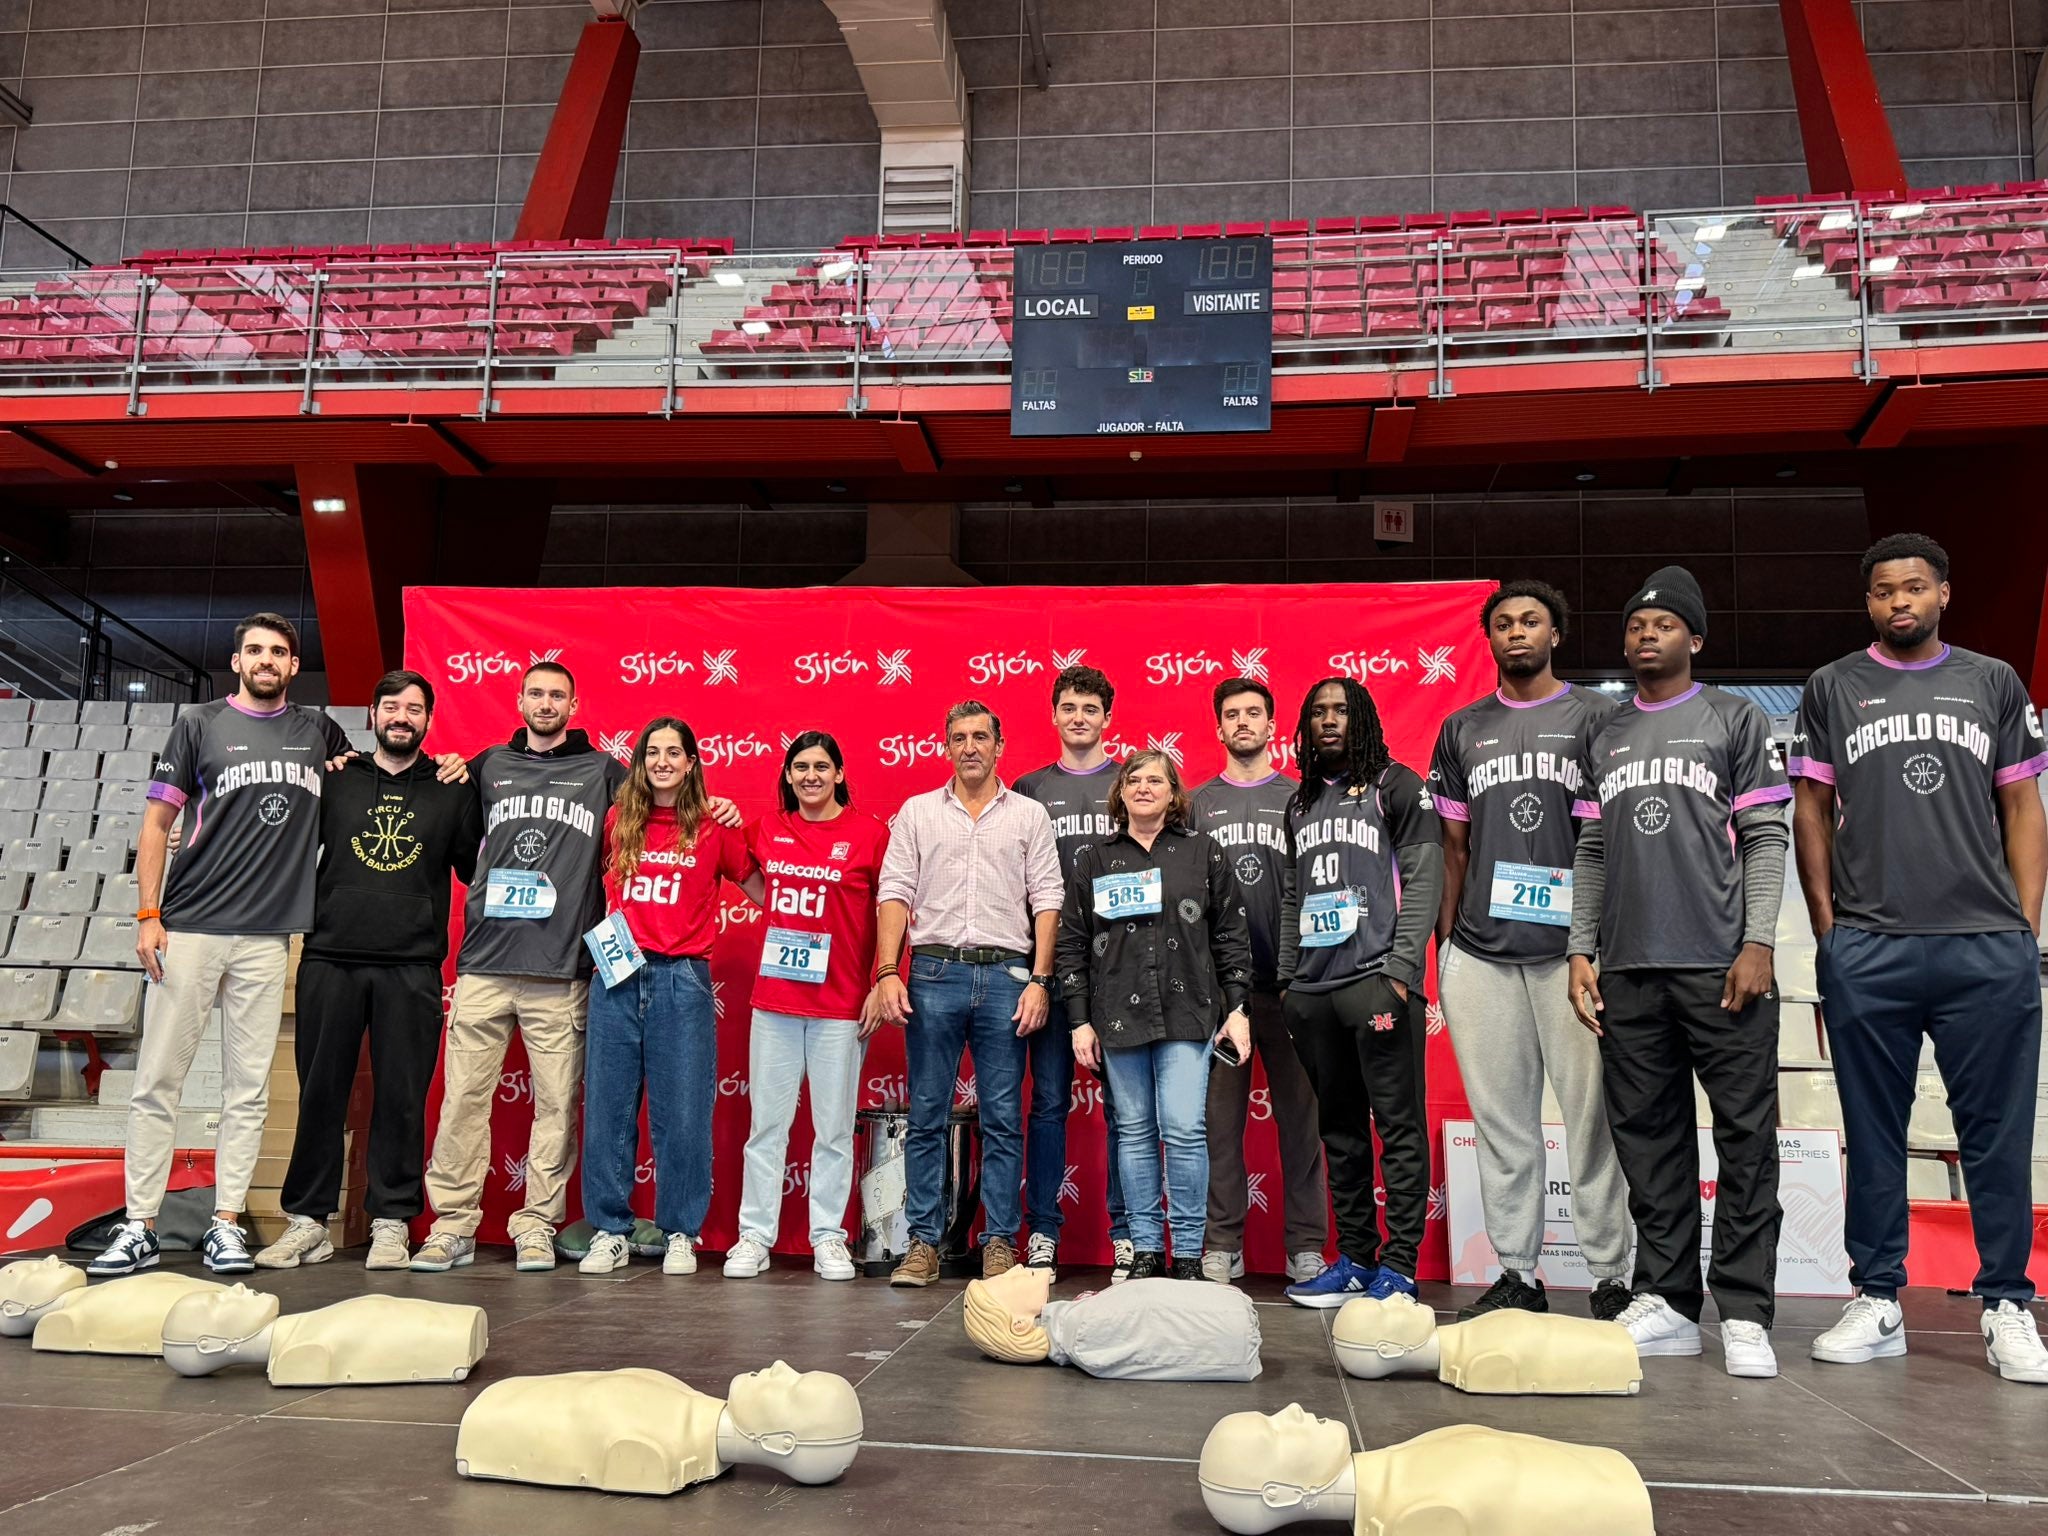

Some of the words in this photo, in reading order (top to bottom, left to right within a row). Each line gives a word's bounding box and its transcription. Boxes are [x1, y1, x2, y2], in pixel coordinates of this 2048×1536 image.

[1123, 254, 1163, 265] PERIODO
[1024, 298, 1091, 317] LOCAL
[1193, 292, 1260, 312] VISITANTE
[1022, 400, 1056, 411] FALTAS
[1223, 396, 1258, 407] FALTAS
[1097, 422, 1145, 433] JUGADOR
[1155, 421, 1184, 432] FALTA
[447, 651, 522, 684] gijón
[620, 651, 695, 685] gijón
[794, 650, 869, 684] gijón
[969, 650, 1044, 685] gijón
[1146, 650, 1223, 685] gijón
[697, 733, 772, 767] gijón
[1845, 713, 1931, 765] CÍRCULO
[1935, 714, 1990, 766] GIJÓN
[214, 760, 283, 798] CÍRCULO
[366, 805, 415, 819] CIRCUO
[546, 796, 595, 837] GIJÓN
[1050, 813, 1093, 840] RCULO
[1333, 816, 1379, 854] GIJÓN
[639, 850, 696, 868] ecable
[766, 858, 842, 882] telecable
[1311, 852, 1339, 886] 40
[504, 886, 538, 906] 218
[622, 869, 682, 905] iati
[770, 878, 828, 919] iati
[1108, 886, 1145, 908] 585
[1512, 883, 1551, 908] 216
[1310, 910, 1341, 933] 219
[600, 933, 624, 967] 212
[778, 946, 811, 969] 213
[1779, 1149, 1830, 1159] USTRIES
[1540, 1249, 1560, 1257] LMAS
